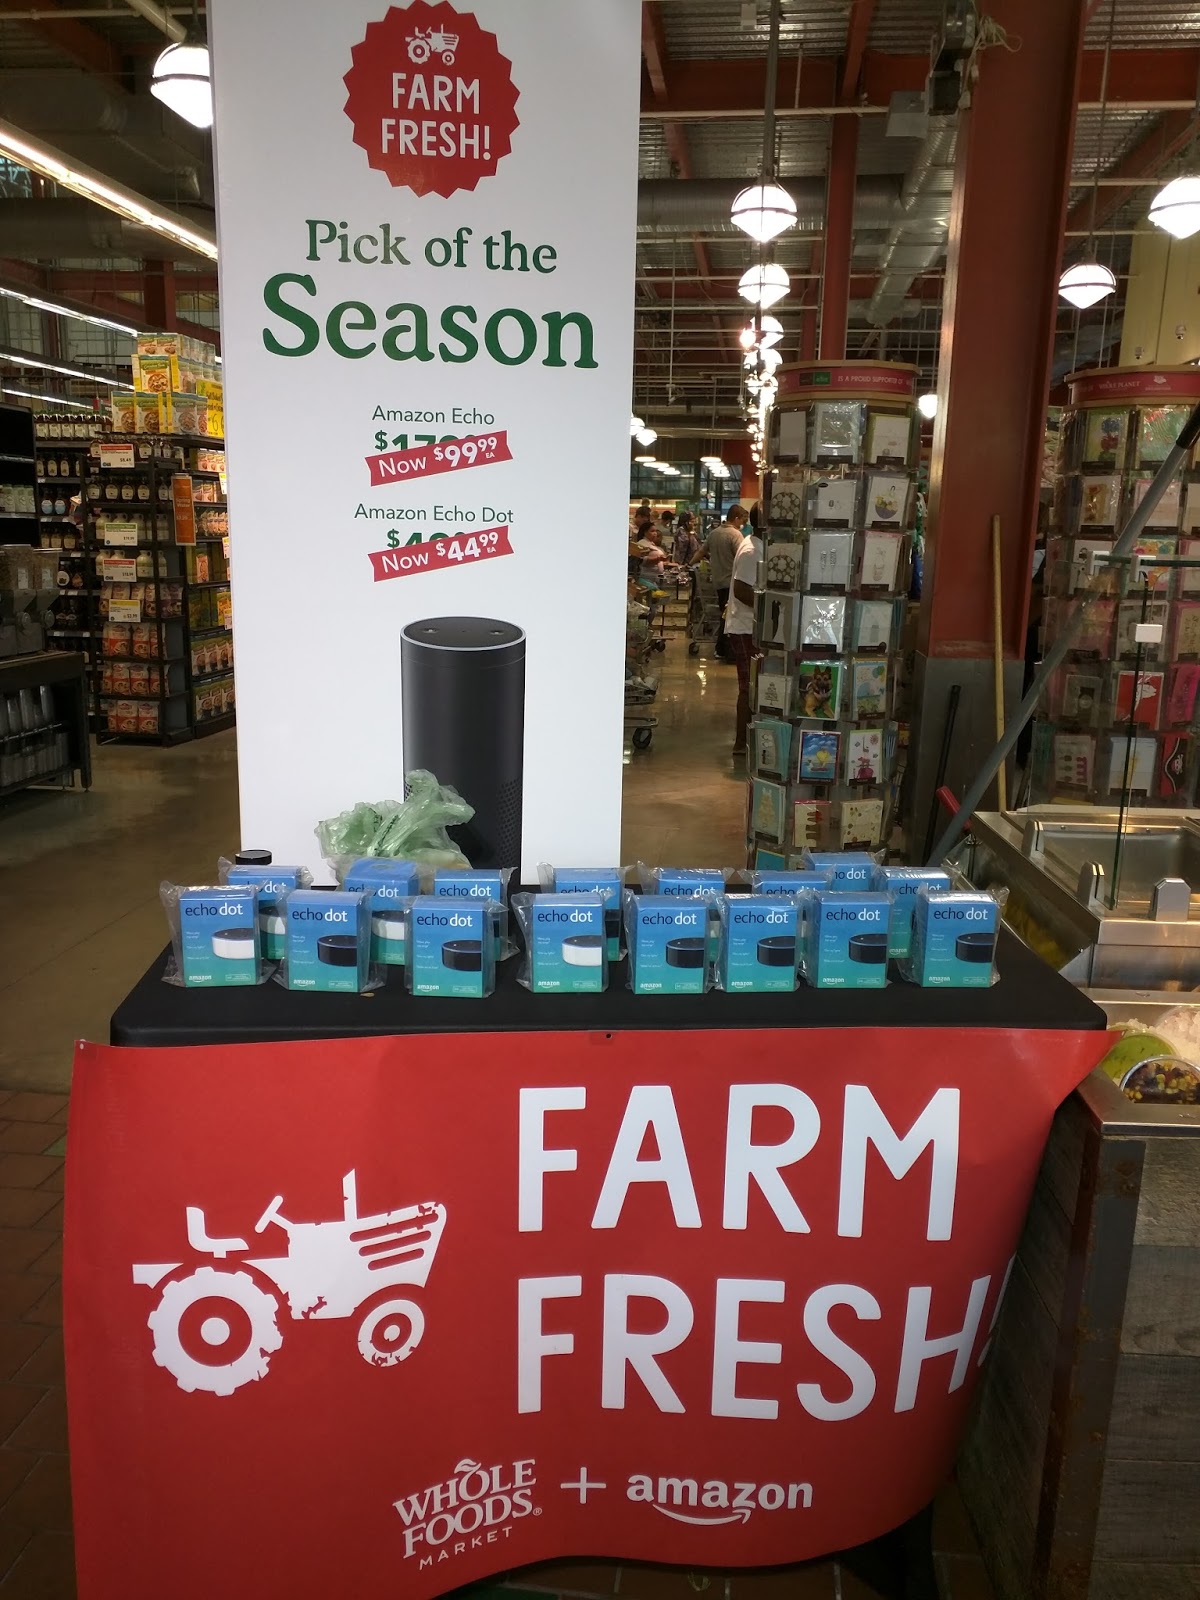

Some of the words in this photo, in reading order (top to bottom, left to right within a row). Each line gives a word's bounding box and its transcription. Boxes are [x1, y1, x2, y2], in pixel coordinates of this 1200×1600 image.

[392, 72, 480, 114] FARM
[381, 118, 491, 160] FRESH!
[305, 219, 411, 265] Pick
[424, 227, 473, 267] of
[483, 230, 557, 274] the
[262, 272, 599, 369] Season
[372, 405, 445, 423] Amazon
[452, 407, 495, 425] Echo
[378, 457, 426, 477] Now
[354, 503, 427, 521] Amazon
[433, 505, 476, 522] Echo
[482, 507, 514, 523] Dot
[382, 552, 429, 573] Now
[847, 868, 867, 880] dot
[378, 885, 399, 898] dot
[439, 884, 469, 897] echo
[470, 885, 491, 897] dot
[664, 885, 693, 896] echo
[899, 883, 919, 895] cho
[185, 903, 217, 916] echo
[219, 902, 243, 916] dot
[292, 908, 323, 921] echo
[324, 908, 348, 922] dot
[537, 909, 568, 923] echo
[570, 909, 592, 923] dot
[826, 908, 857, 921] echo
[858, 907, 881, 921] dot
[933, 907, 965, 921] echo
[966, 907, 988, 920] dot
[416, 912, 449, 926] echo
[449, 913, 473, 927] dot
[642, 912, 673, 925] echo
[674, 912, 697, 925] dot
[734, 911, 765, 924] echo
[766, 911, 789, 924] dot
[518, 1084, 960, 1241] FARM
[392, 1458, 537, 1526] WHOLE
[627, 1475, 814, 1513] amazon
[419, 1526, 513, 1571] MARKET
